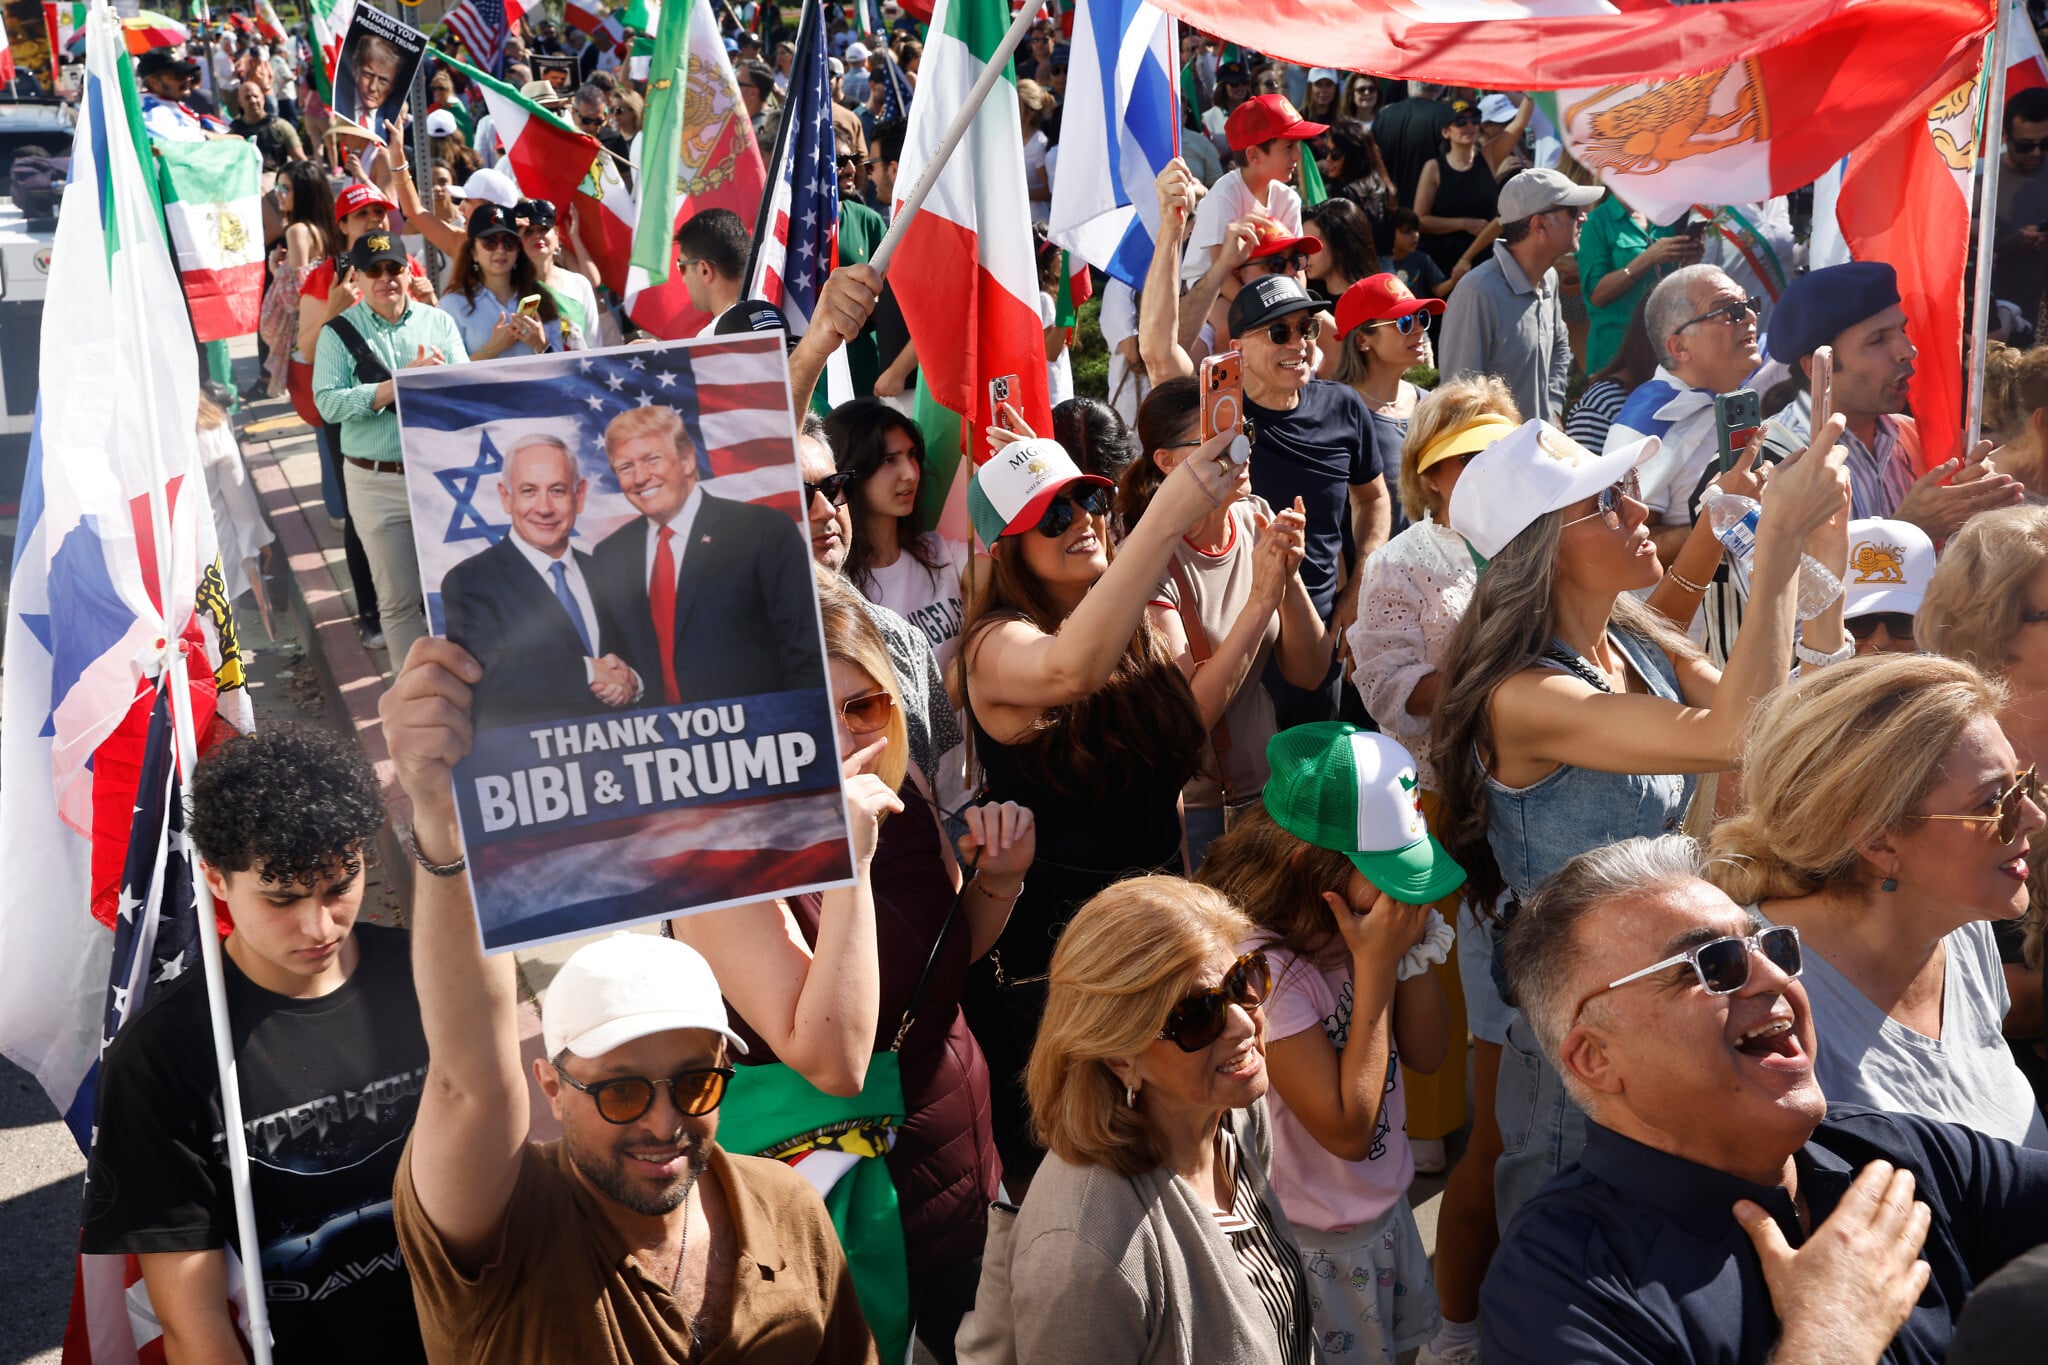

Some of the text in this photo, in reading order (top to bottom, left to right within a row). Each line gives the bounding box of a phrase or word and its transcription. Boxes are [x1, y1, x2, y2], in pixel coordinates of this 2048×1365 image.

[355, 15, 420, 53] PRESIDENT TRUMP
[367, 9, 417, 41] THANK YOU
[907, 598, 964, 648] NGELE
[530, 703, 746, 760] THANK YOU
[474, 731, 817, 833] BIBI & TRUMP
[264, 1244, 402, 1302] DAW
